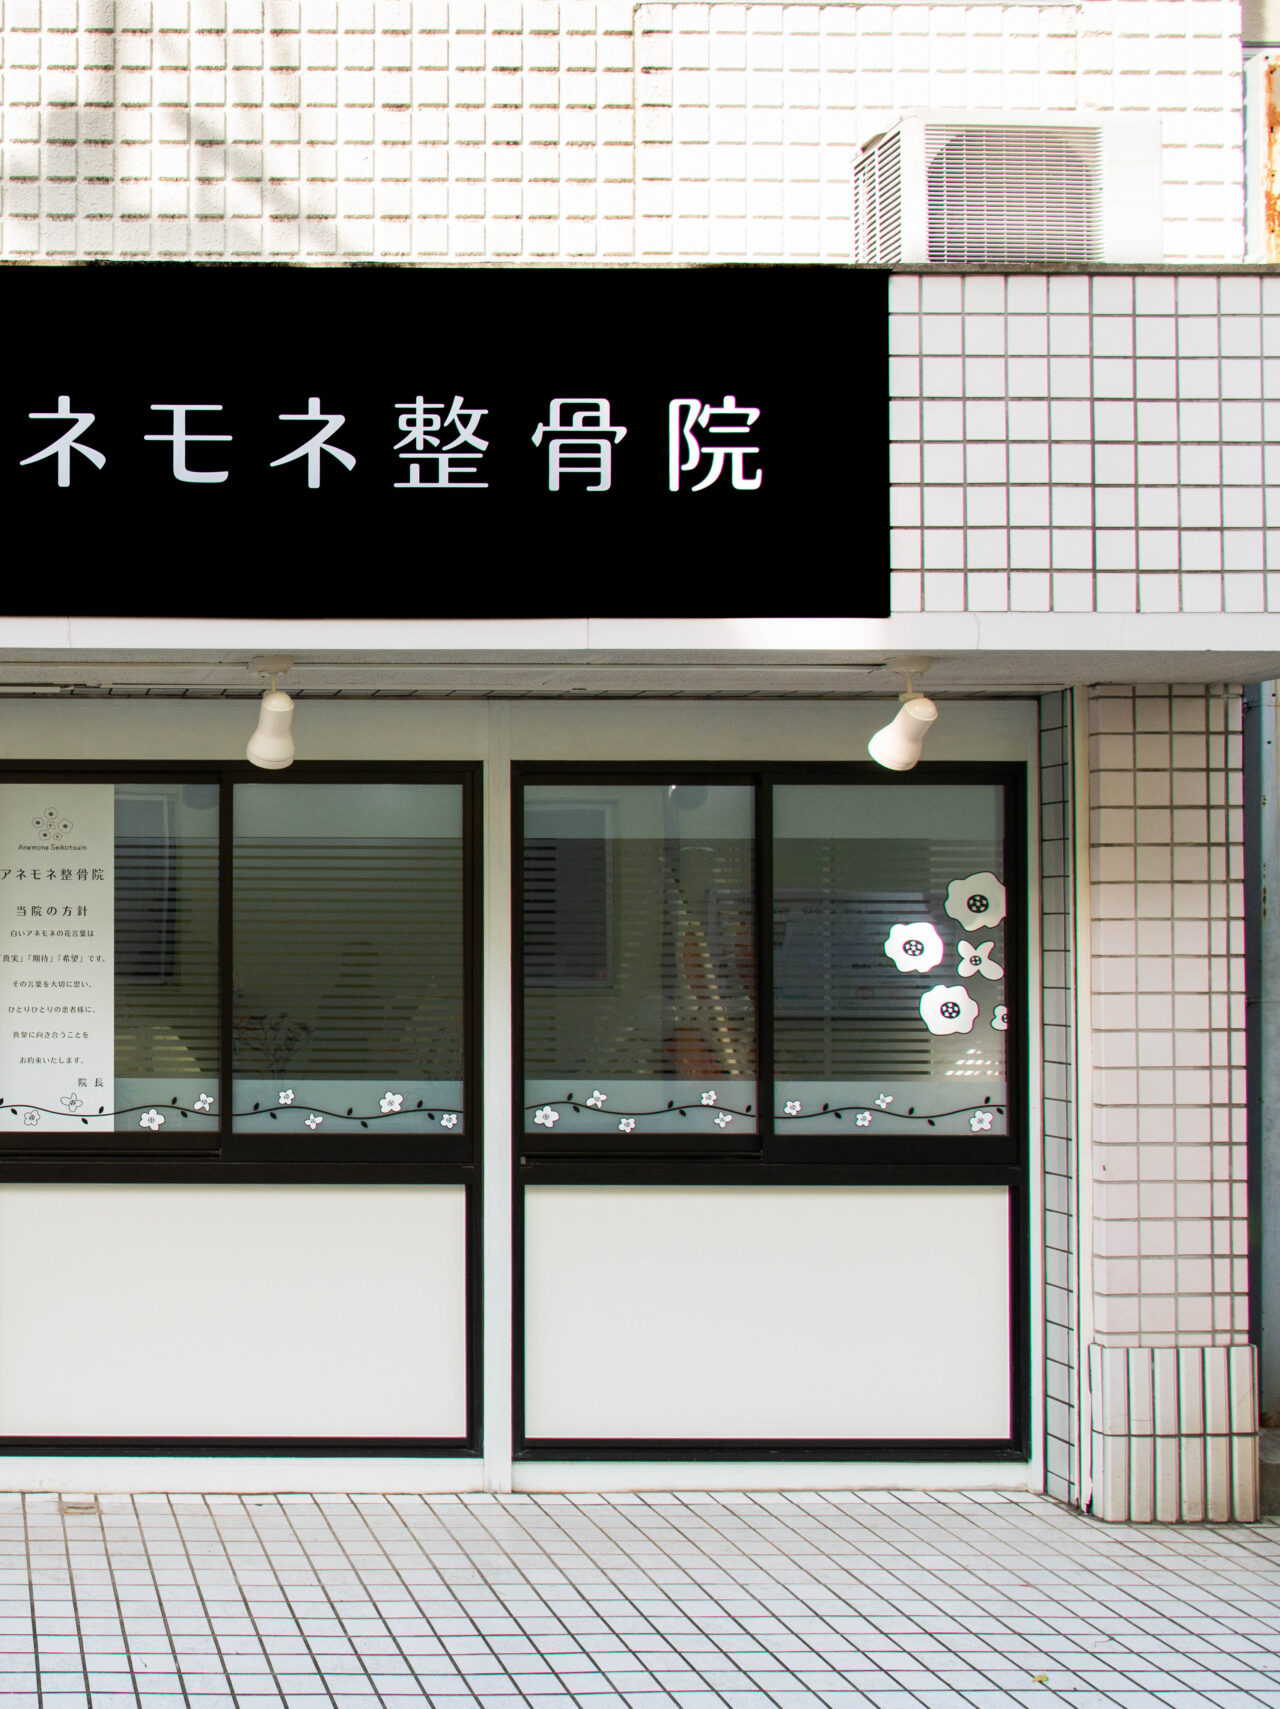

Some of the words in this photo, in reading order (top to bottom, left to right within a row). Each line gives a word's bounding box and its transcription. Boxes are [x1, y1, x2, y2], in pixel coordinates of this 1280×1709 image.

[0, 868, 105, 881] アネモネ整骨院
[16, 905, 88, 917] 当院の方針
[10, 930, 94, 938] 白いアネモネの花言葉は
[77, 1077, 104, 1088] 院長
